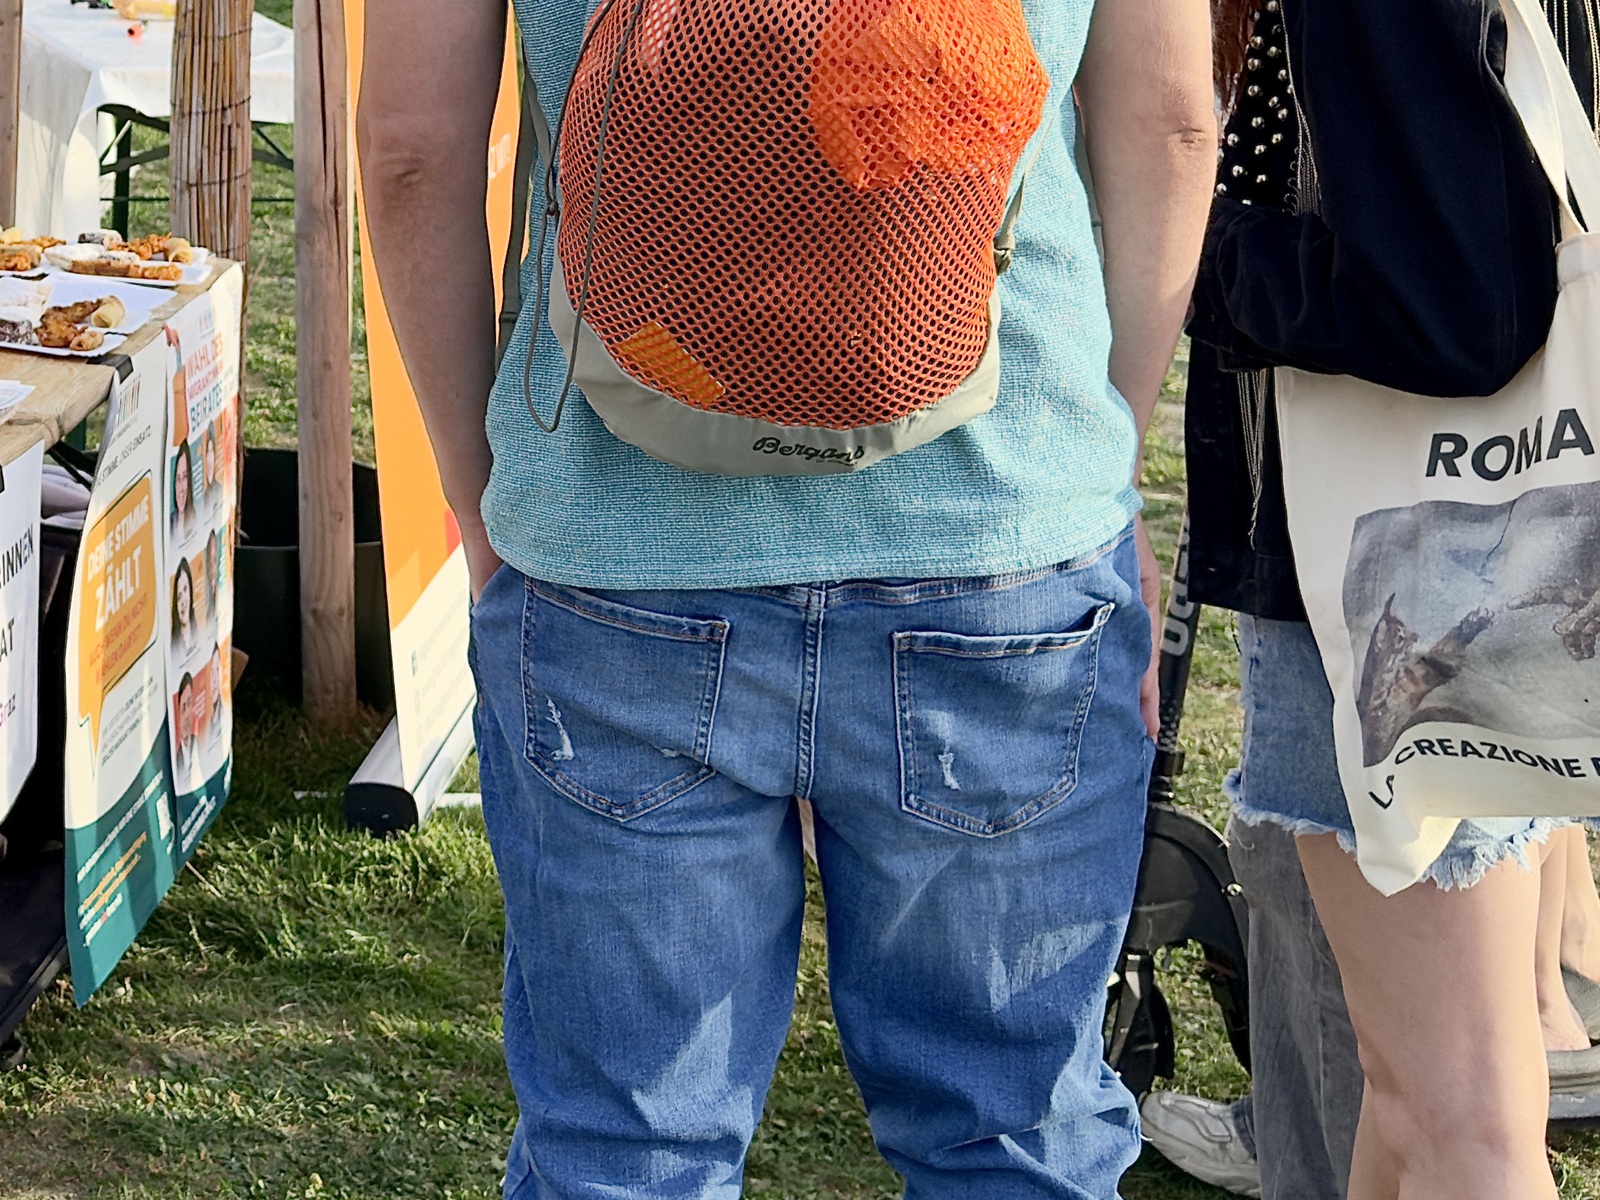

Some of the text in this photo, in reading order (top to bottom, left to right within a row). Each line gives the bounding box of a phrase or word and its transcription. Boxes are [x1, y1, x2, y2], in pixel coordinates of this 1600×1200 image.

[752, 437, 864, 462] Bergans
[1425, 408, 1595, 482] ROMA
[114, 494, 150, 551] STIMME
[95, 544, 142, 633] ZÄHLT
[1393, 737, 1586, 778] CREAZIONE
